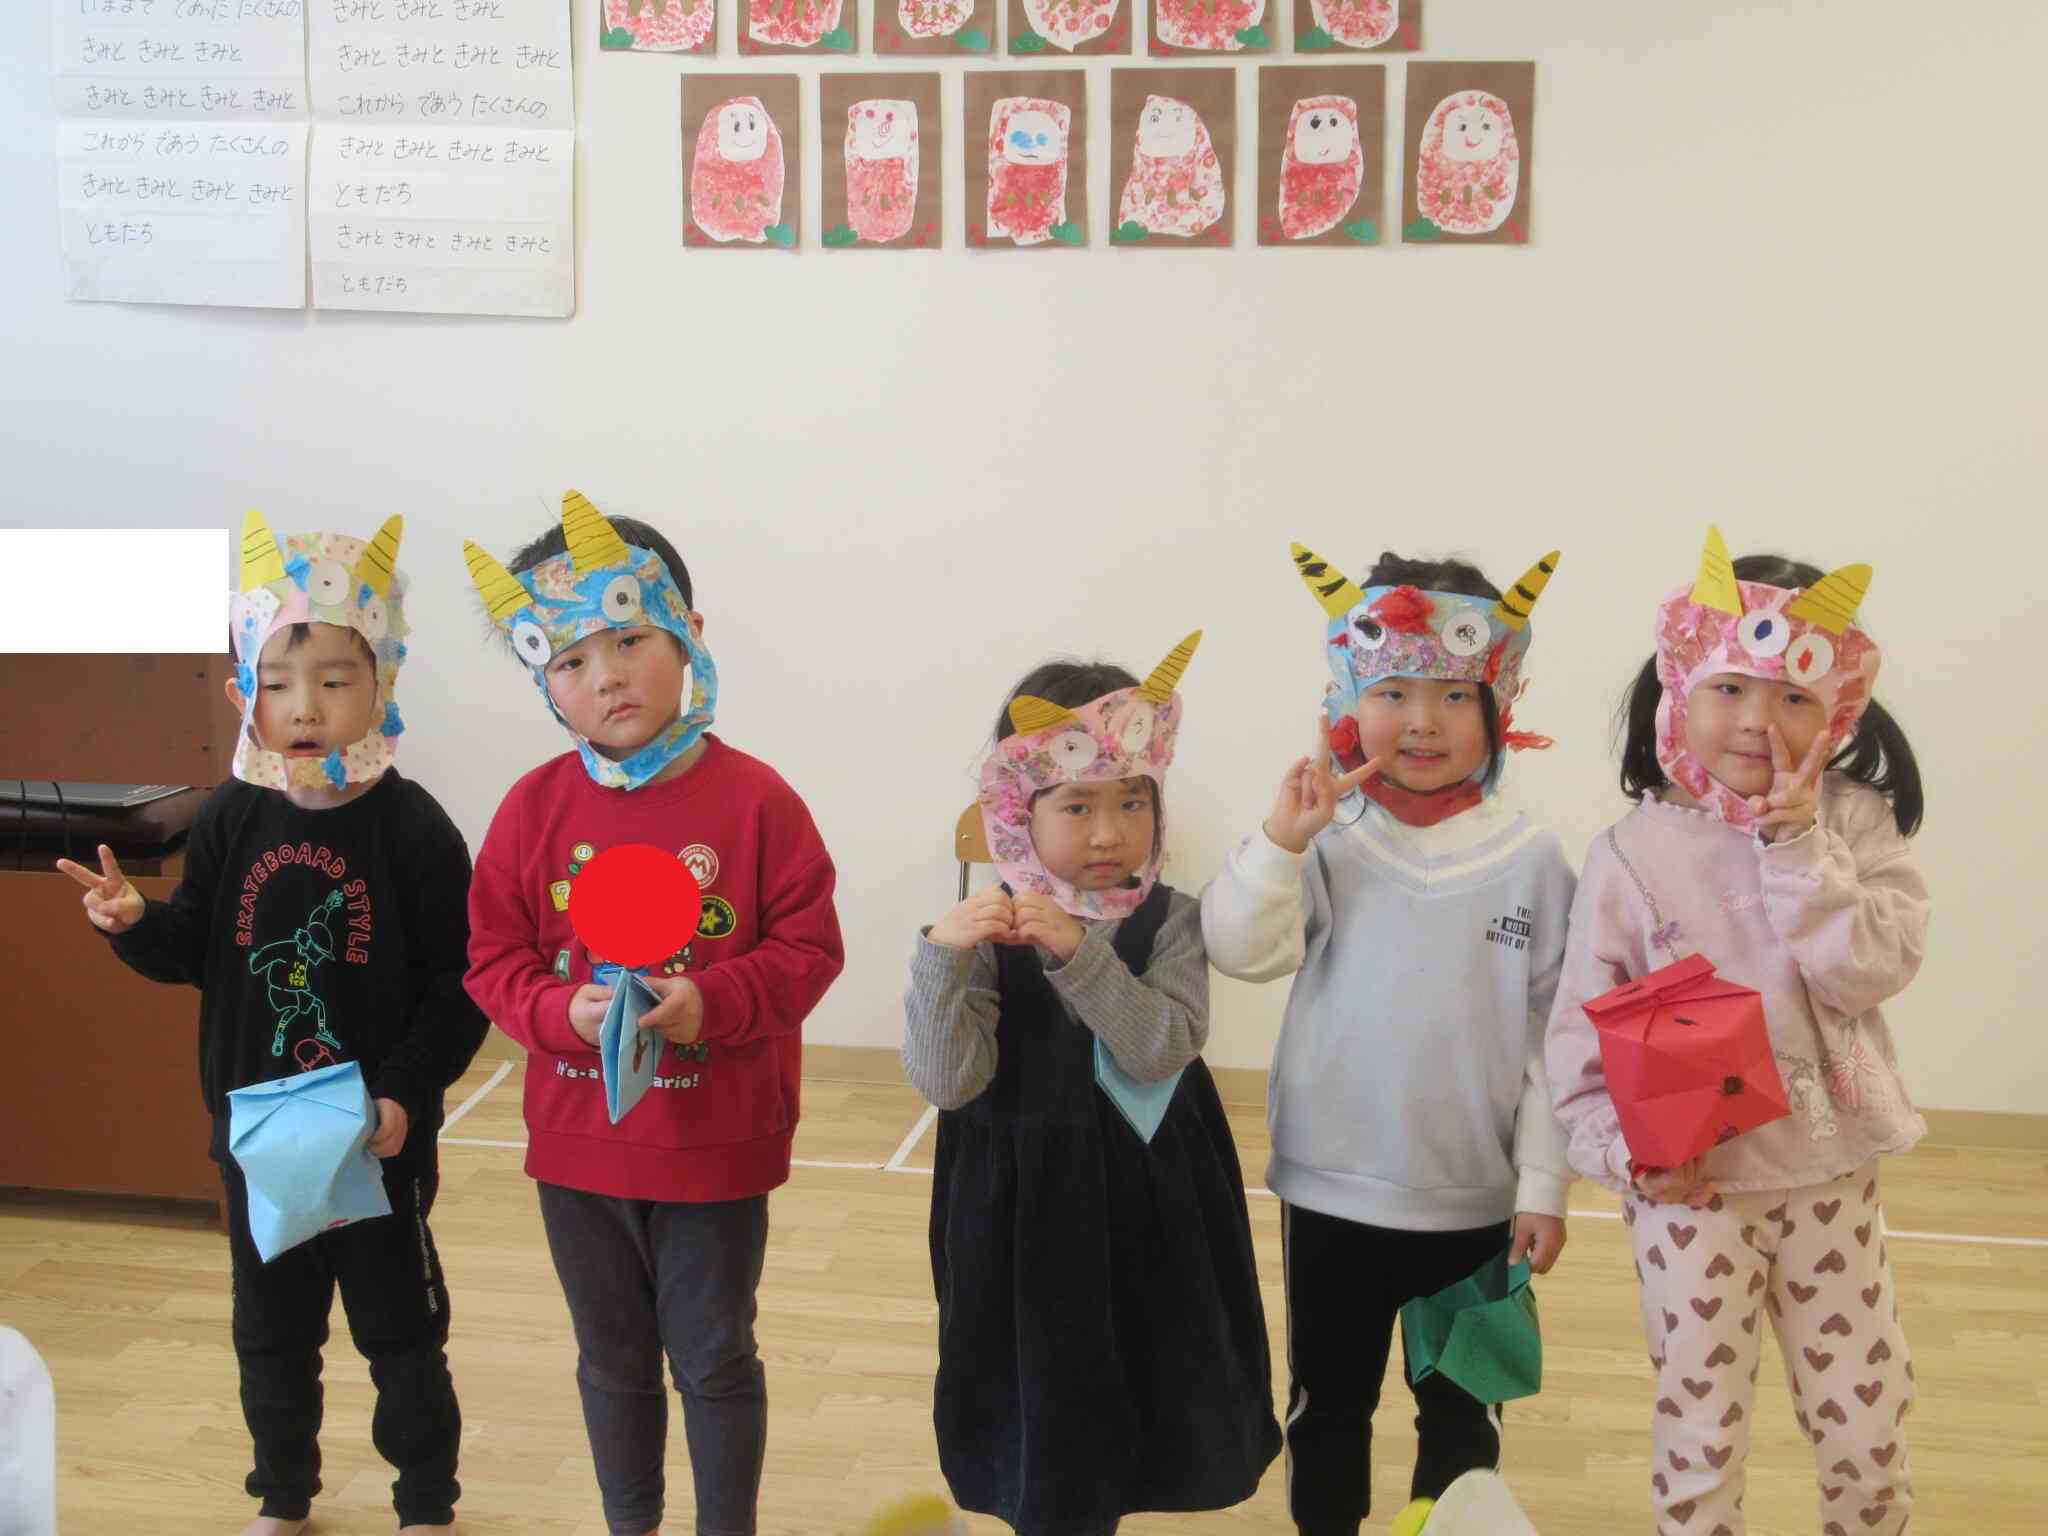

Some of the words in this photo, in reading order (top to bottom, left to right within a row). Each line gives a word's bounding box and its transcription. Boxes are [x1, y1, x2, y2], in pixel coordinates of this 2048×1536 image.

[237, 0, 302, 18] たくさんの
[335, 0, 386, 23] きみと
[393, 0, 444, 21] きみと
[455, 0, 505, 21] きみと
[82, 36, 128, 64] きみと
[137, 39, 185, 63] きみと
[193, 41, 243, 63] きみと
[337, 44, 387, 72] きみと
[396, 42, 446, 68] きみと
[453, 41, 504, 69] きみと
[513, 44, 561, 70] きみと
[85, 85, 136, 111] きみと
[144, 86, 196, 109] きみと
[201, 85, 243, 111] きみと
[252, 87, 297, 111] きみと
[336, 92, 406, 116] これから
[416, 88, 464, 118] であう
[470, 92, 549, 119] たくさんの
[81, 132, 146, 152] これから
[155, 129, 201, 155] であう
[209, 134, 289, 156] たくさんの
[336, 136, 385, 160] きみと
[393, 136, 442, 161] きみと
[448, 139, 496, 162] きみと
[503, 139, 552, 163] きみと
[81, 172, 131, 198] きみと
[135, 175, 185, 200] きみと
[191, 178, 240, 201] きみと
[247, 183, 296, 204] きみと
[335, 181, 413, 208] ともだち
[86, 221, 154, 245] ともだち
[336, 223, 386, 249] きみと
[392, 231, 437, 249] きみと
[449, 231, 496, 252] きみと
[504, 234, 553, 254] きみと
[341, 272, 409, 295] ともだち
[235, 842, 347, 947] SKATEBOARD
[343, 879, 370, 965] STYLE
[1485, 930, 1514, 947] OUTFIT
[652, 1073, 700, 1089] ario!
